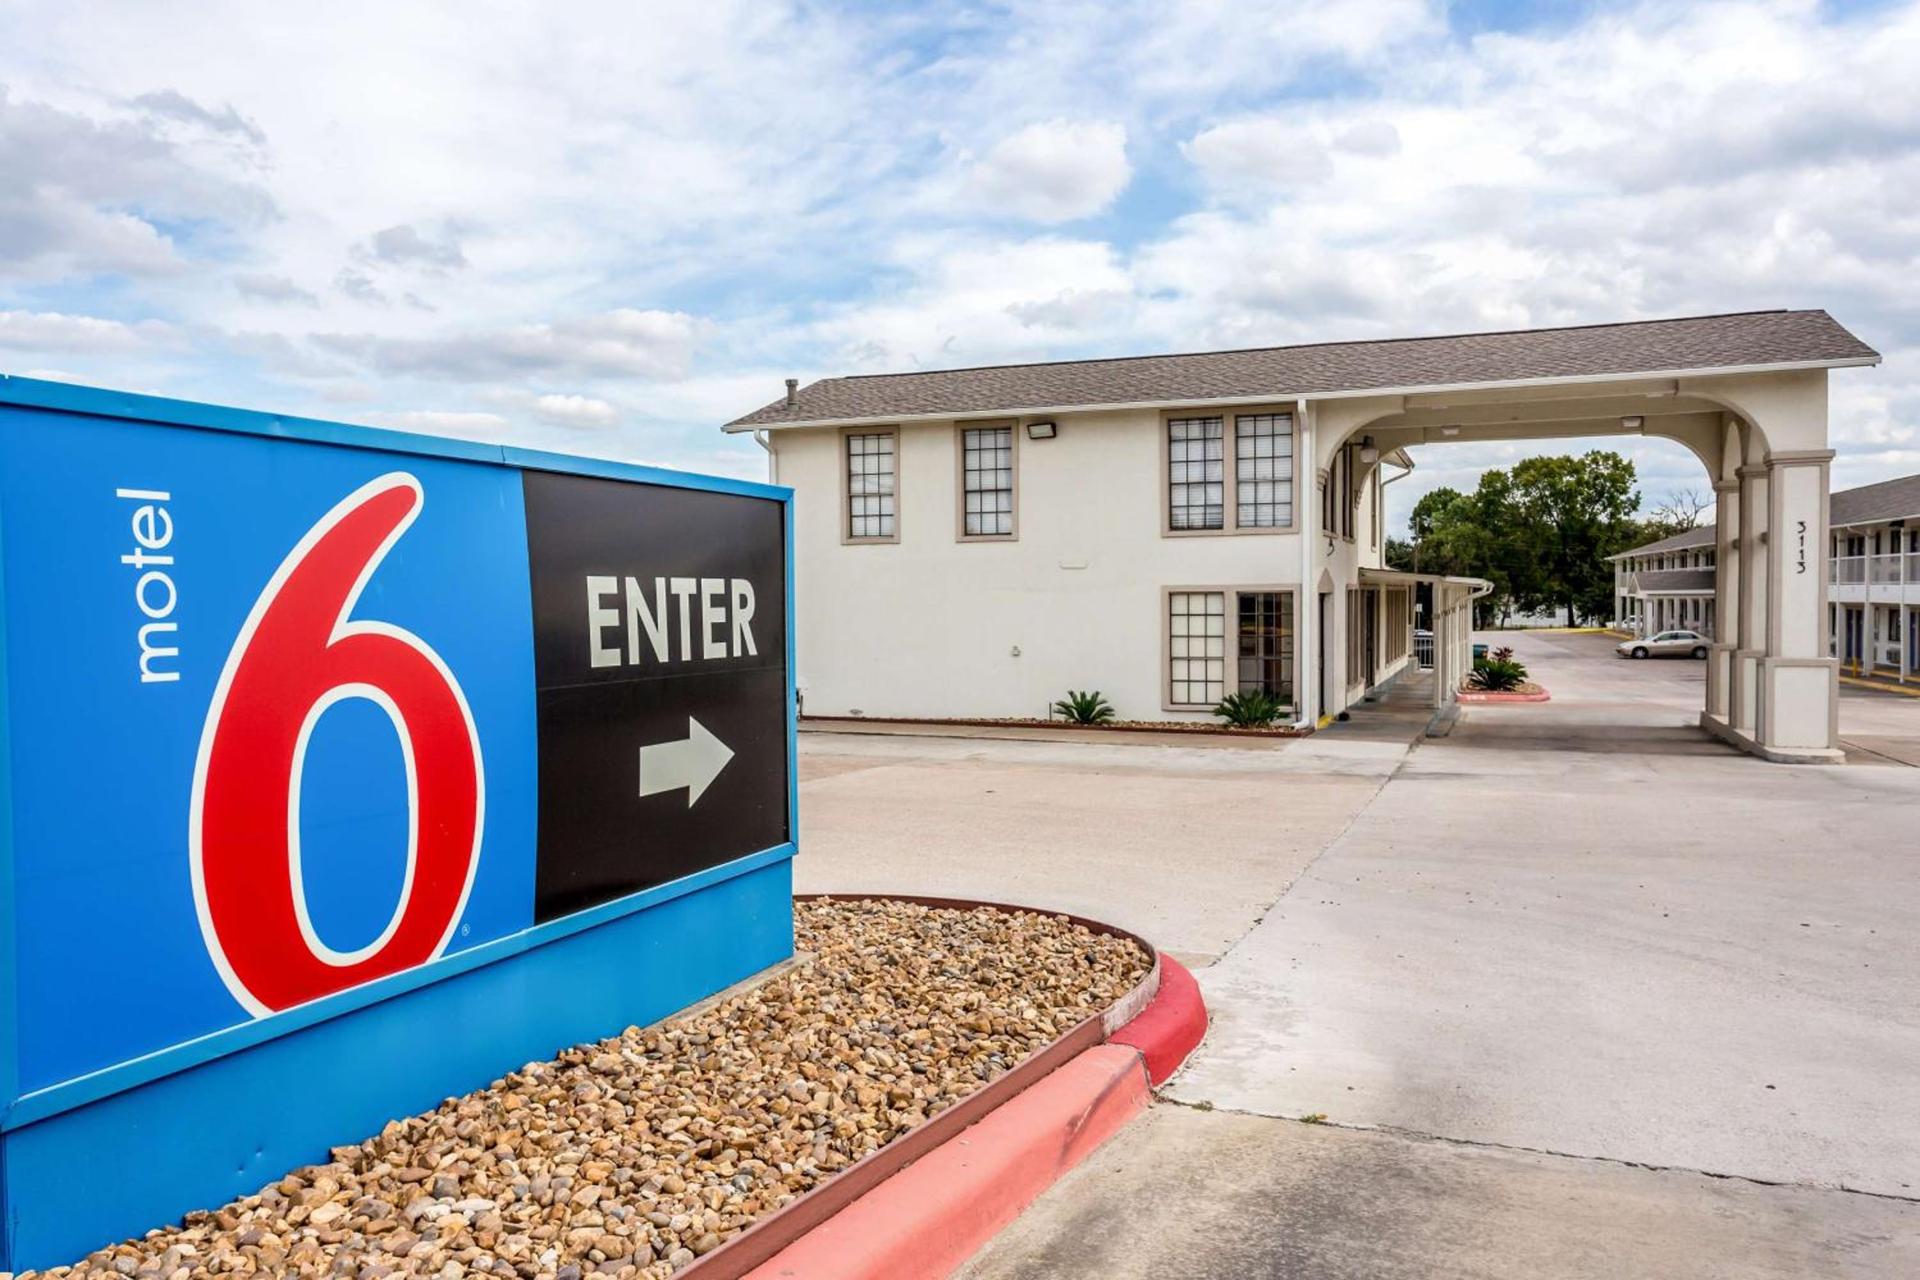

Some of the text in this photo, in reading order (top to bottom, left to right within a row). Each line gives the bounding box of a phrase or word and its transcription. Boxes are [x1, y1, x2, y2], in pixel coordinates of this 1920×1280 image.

[116, 488, 180, 683] motel
[1797, 521, 1806, 574] 3113
[587, 576, 758, 668] ENTER
[189, 471, 485, 1018] 6
